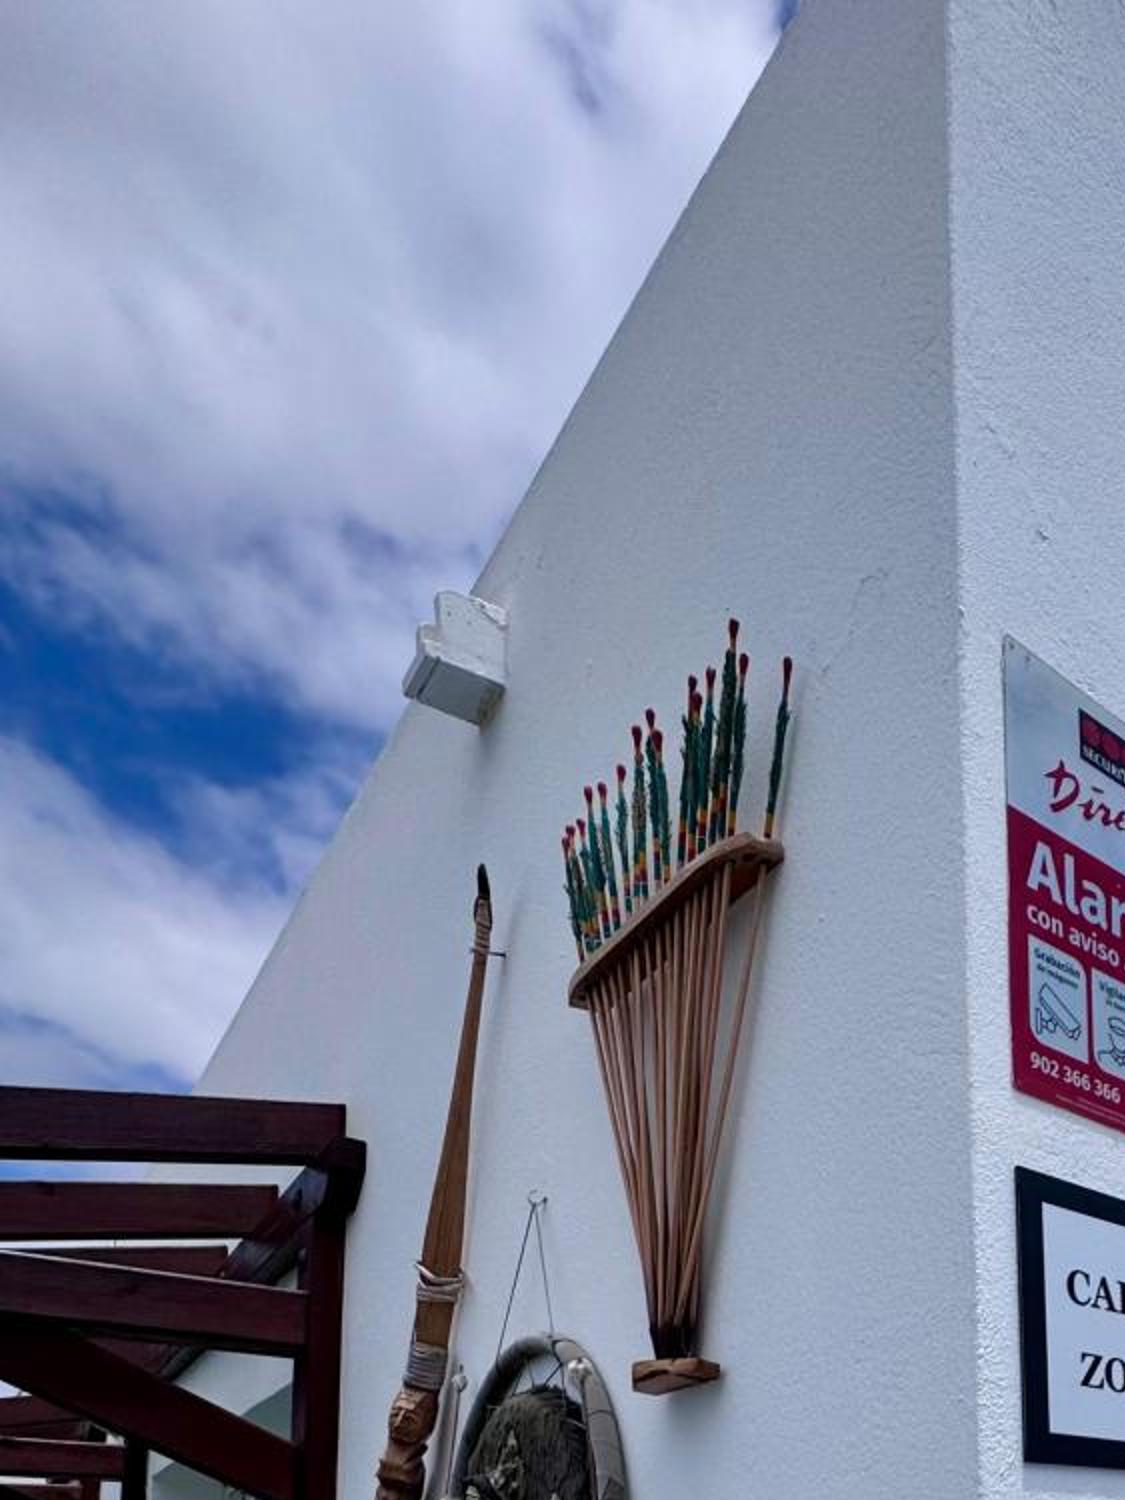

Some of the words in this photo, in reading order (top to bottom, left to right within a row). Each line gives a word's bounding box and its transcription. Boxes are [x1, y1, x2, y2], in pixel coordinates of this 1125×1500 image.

[1026, 904, 1064, 938] con
[1069, 927, 1121, 968] aviso
[1029, 1051, 1060, 1080] 902
[1063, 1065, 1092, 1092] 366
[1093, 1079, 1122, 1105] 366
